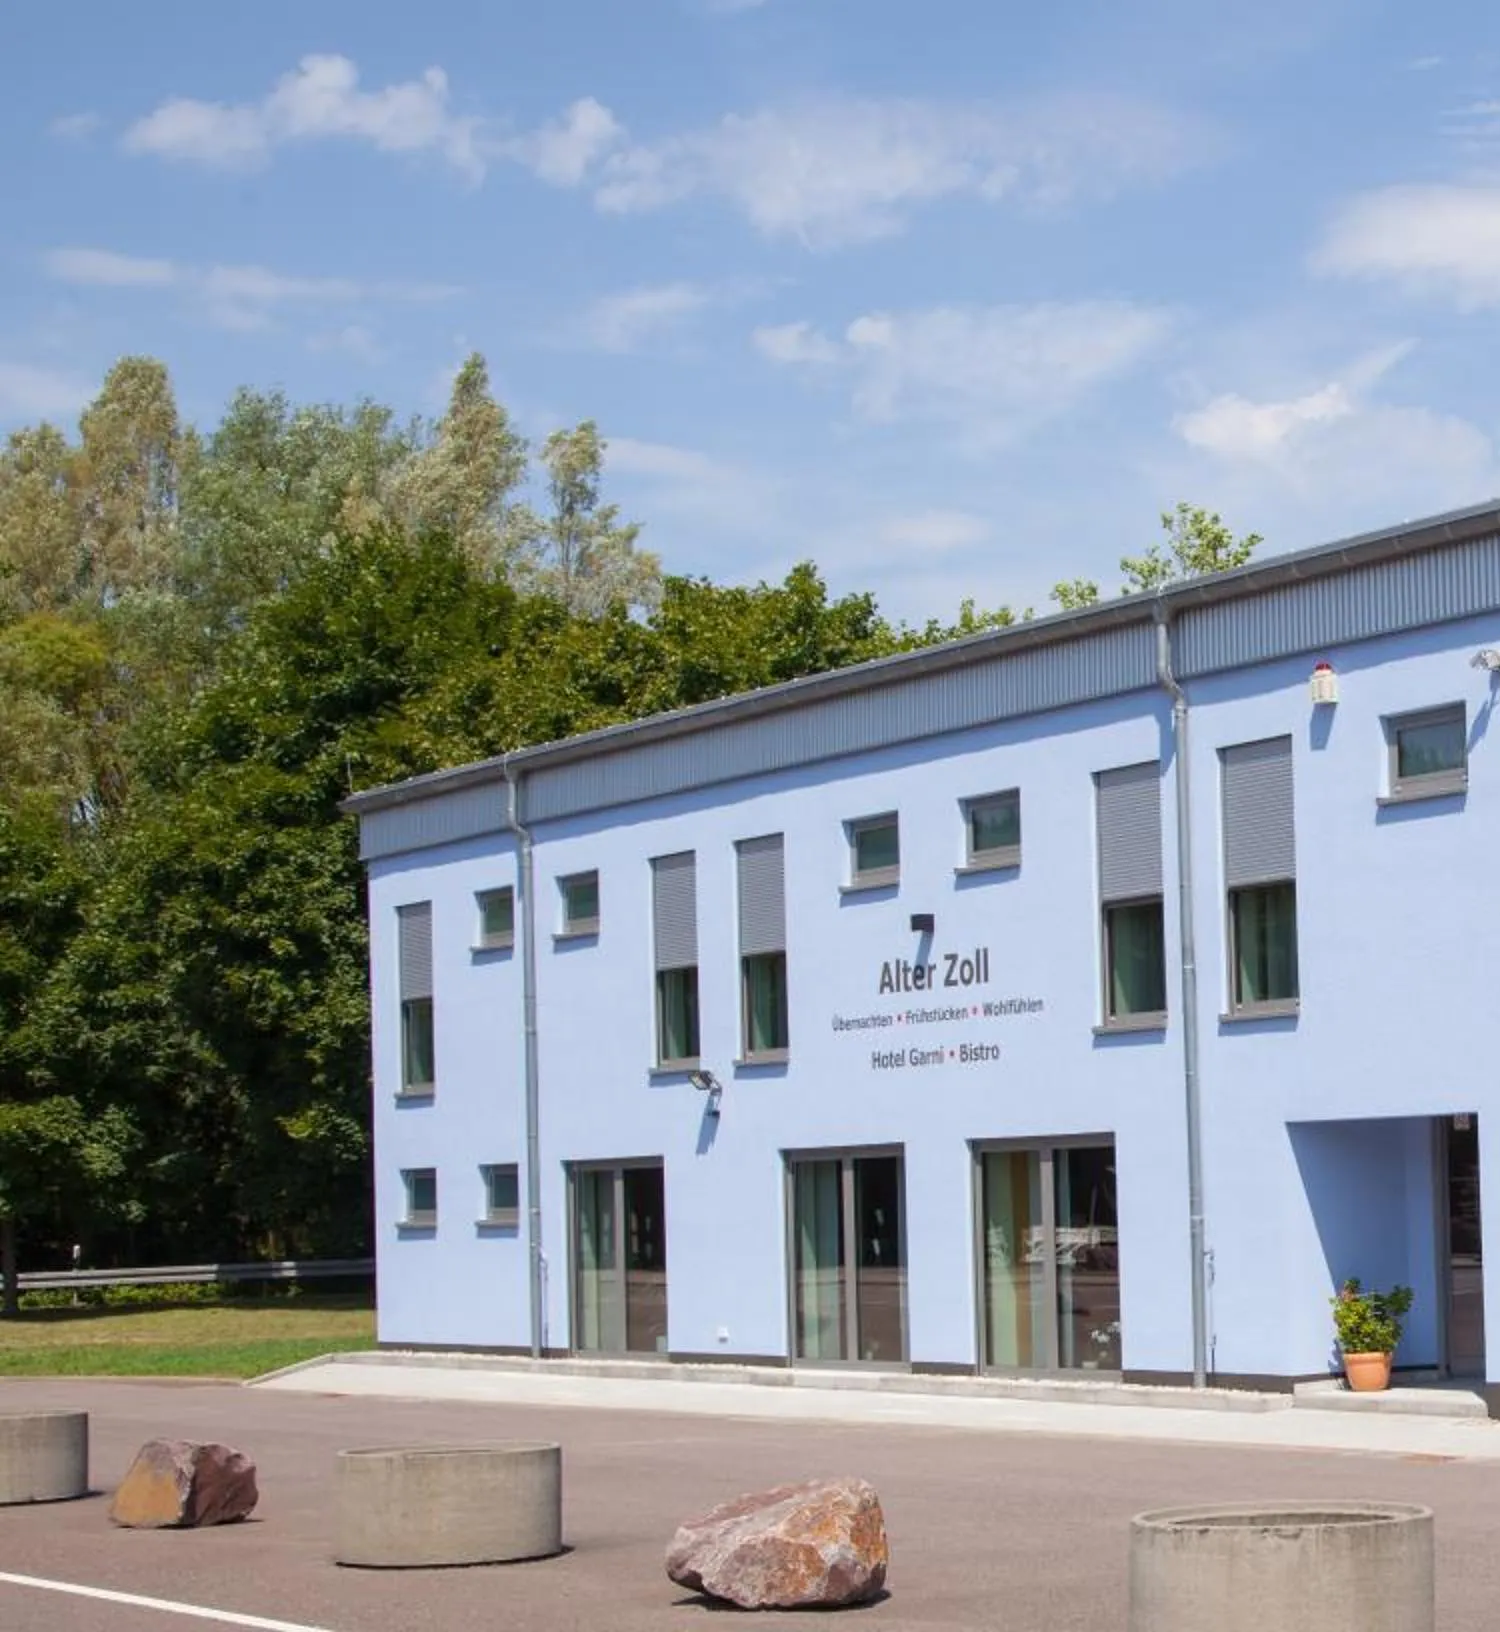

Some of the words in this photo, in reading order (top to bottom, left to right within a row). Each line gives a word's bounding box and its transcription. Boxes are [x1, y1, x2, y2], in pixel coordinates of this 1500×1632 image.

[879, 957, 937, 995] Alter
[944, 947, 989, 988] Zoll
[832, 1014, 894, 1032] Übernachten
[906, 1007, 969, 1025] Frühstücken
[982, 998, 1044, 1017] Wohlfühlen
[872, 1048, 906, 1070] Hotel
[909, 1046, 945, 1067] Garni
[960, 1042, 1001, 1063] Bistro
